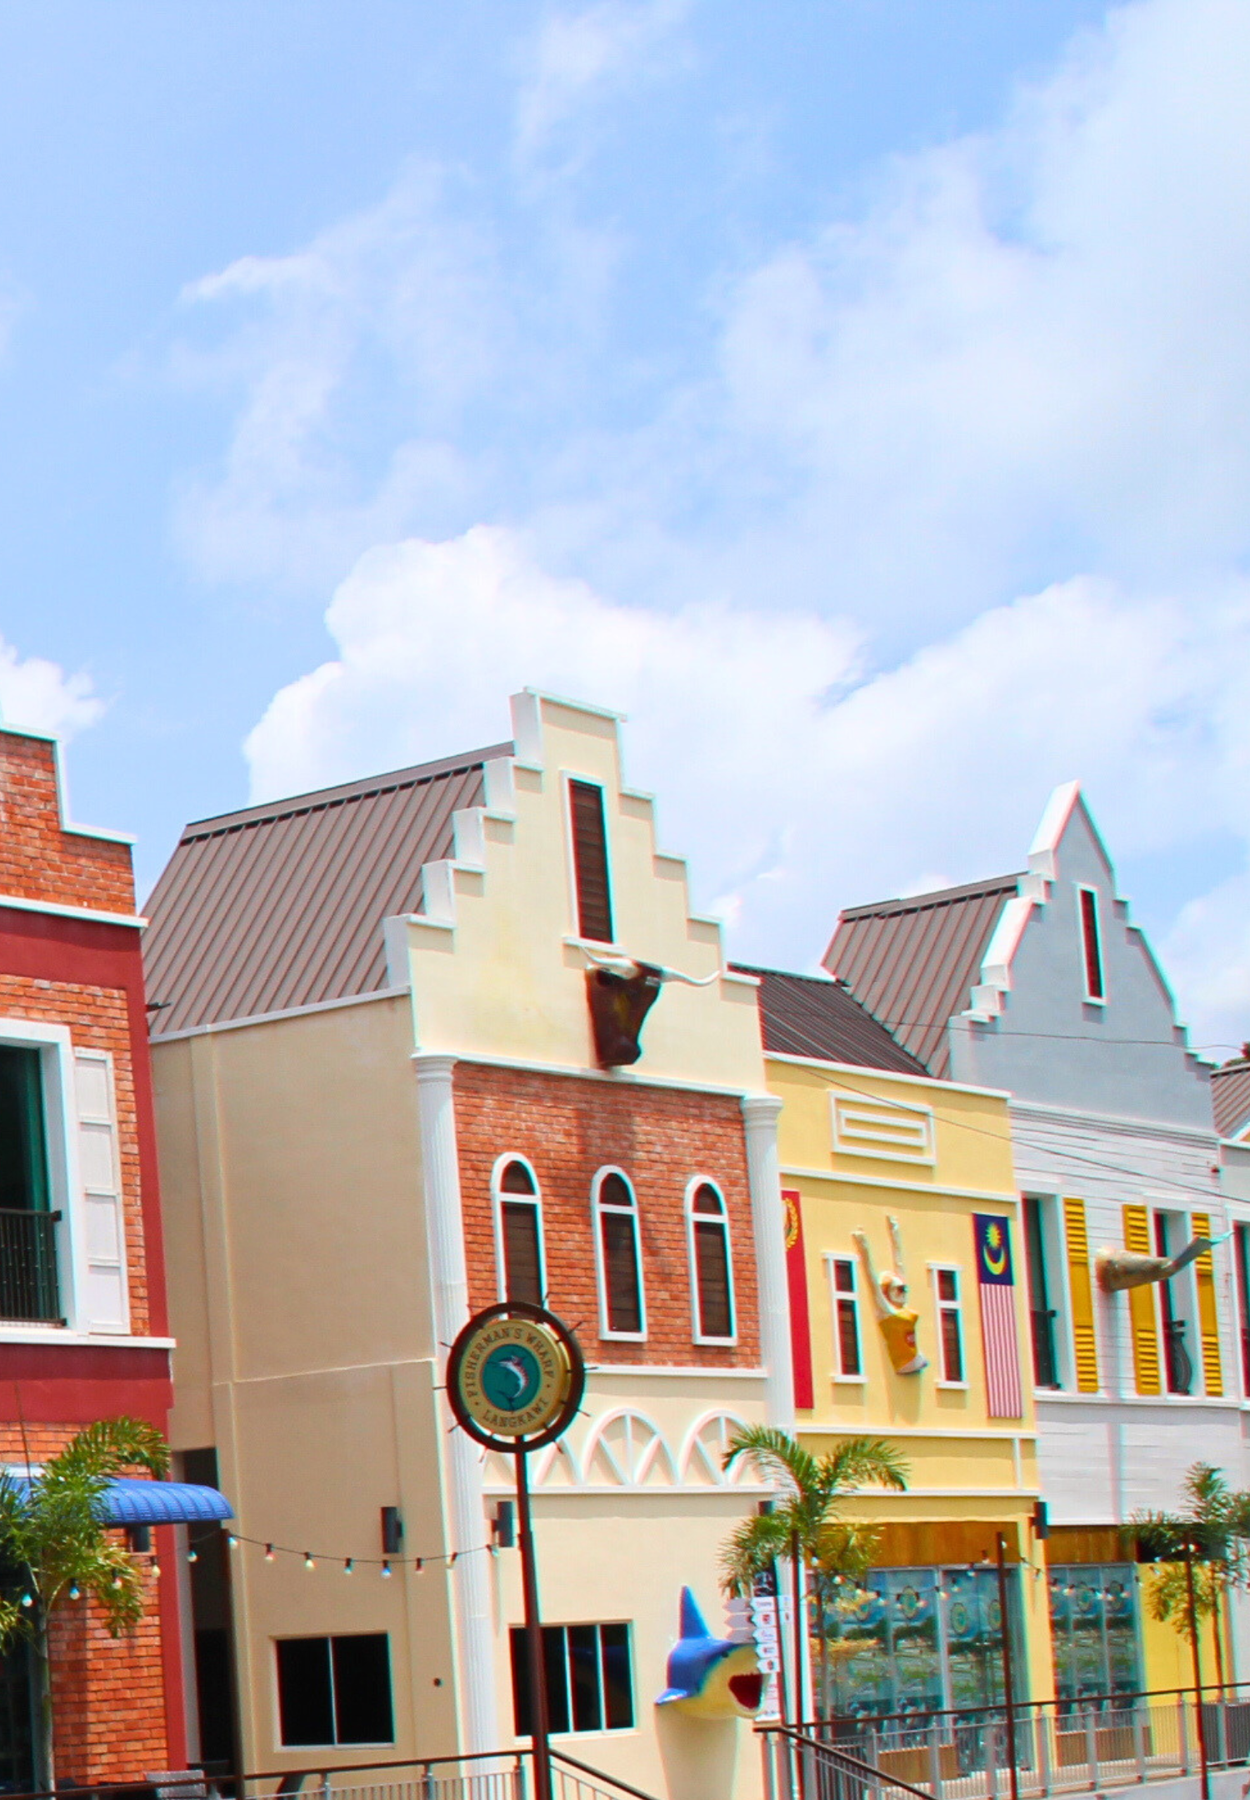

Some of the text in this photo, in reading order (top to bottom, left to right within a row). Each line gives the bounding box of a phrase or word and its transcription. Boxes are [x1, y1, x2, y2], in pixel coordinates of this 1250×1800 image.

[464, 1328, 554, 1397] FISHERMAN'S WHARF
[483, 1398, 547, 1427] LANGKAWI
